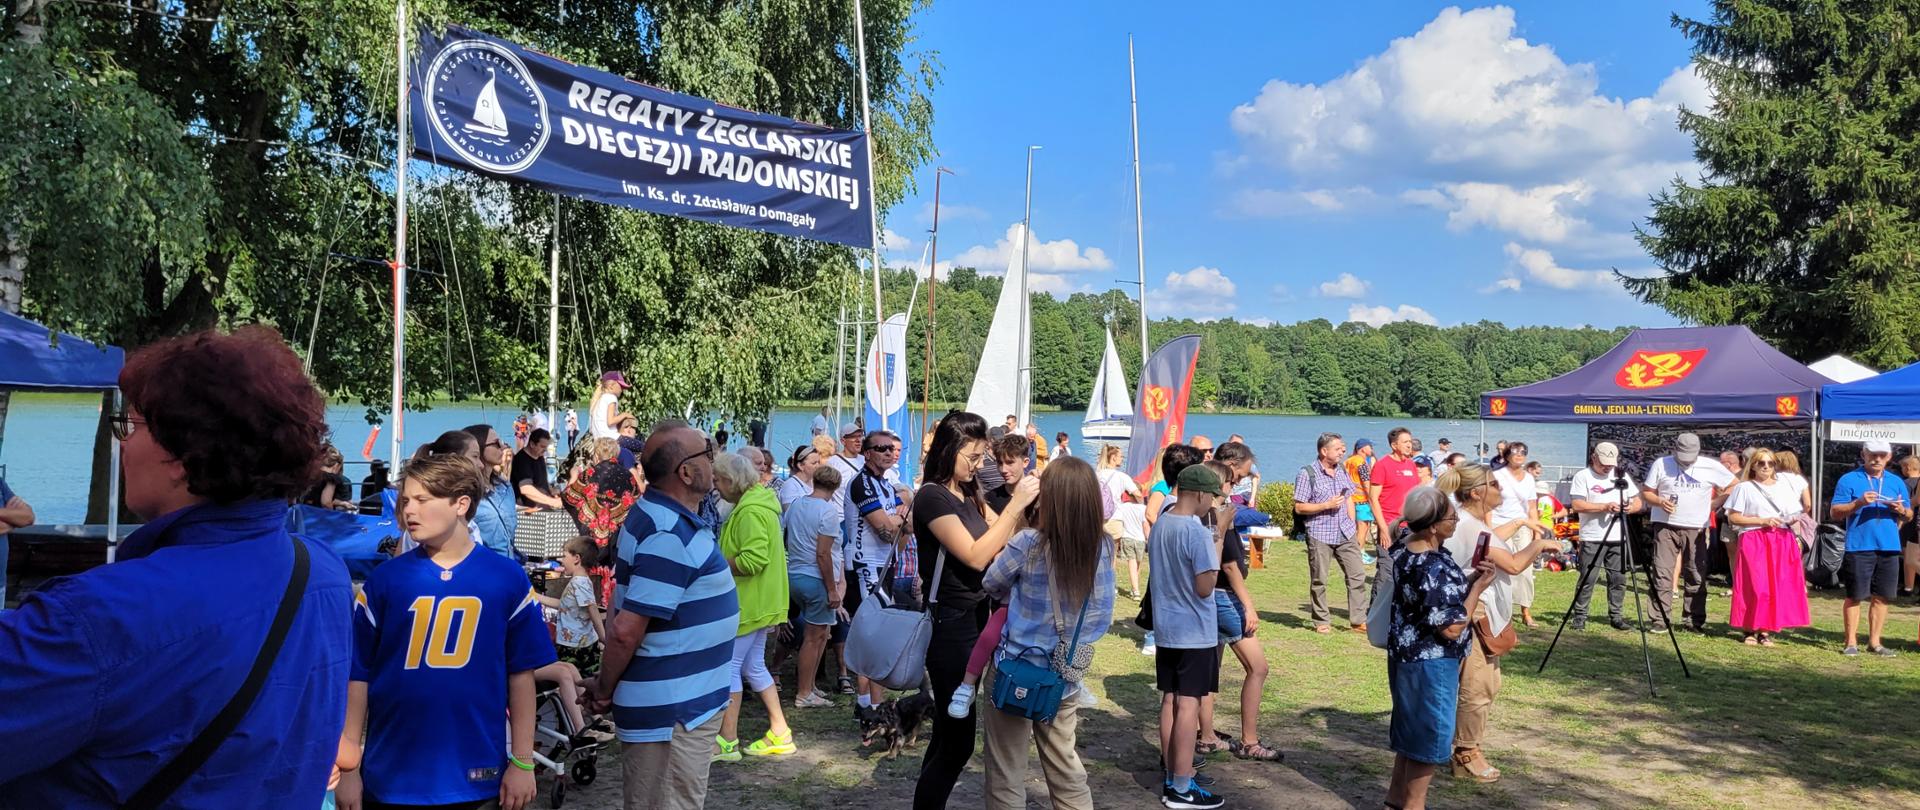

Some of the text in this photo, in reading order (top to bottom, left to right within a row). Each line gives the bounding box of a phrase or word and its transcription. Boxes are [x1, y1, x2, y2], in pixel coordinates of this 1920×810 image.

[568, 80, 852, 169] REGATY ŻEGLARSKIE
[561, 116, 859, 210] DIECEZJI RADOMSKIEJ
[622, 180, 816, 230] im. Ks. dr. Zdzisława Domagały
[1573, 404, 1693, 415] GMINA JEDLNIA-LETNISKO
[404, 595, 483, 670] 10
